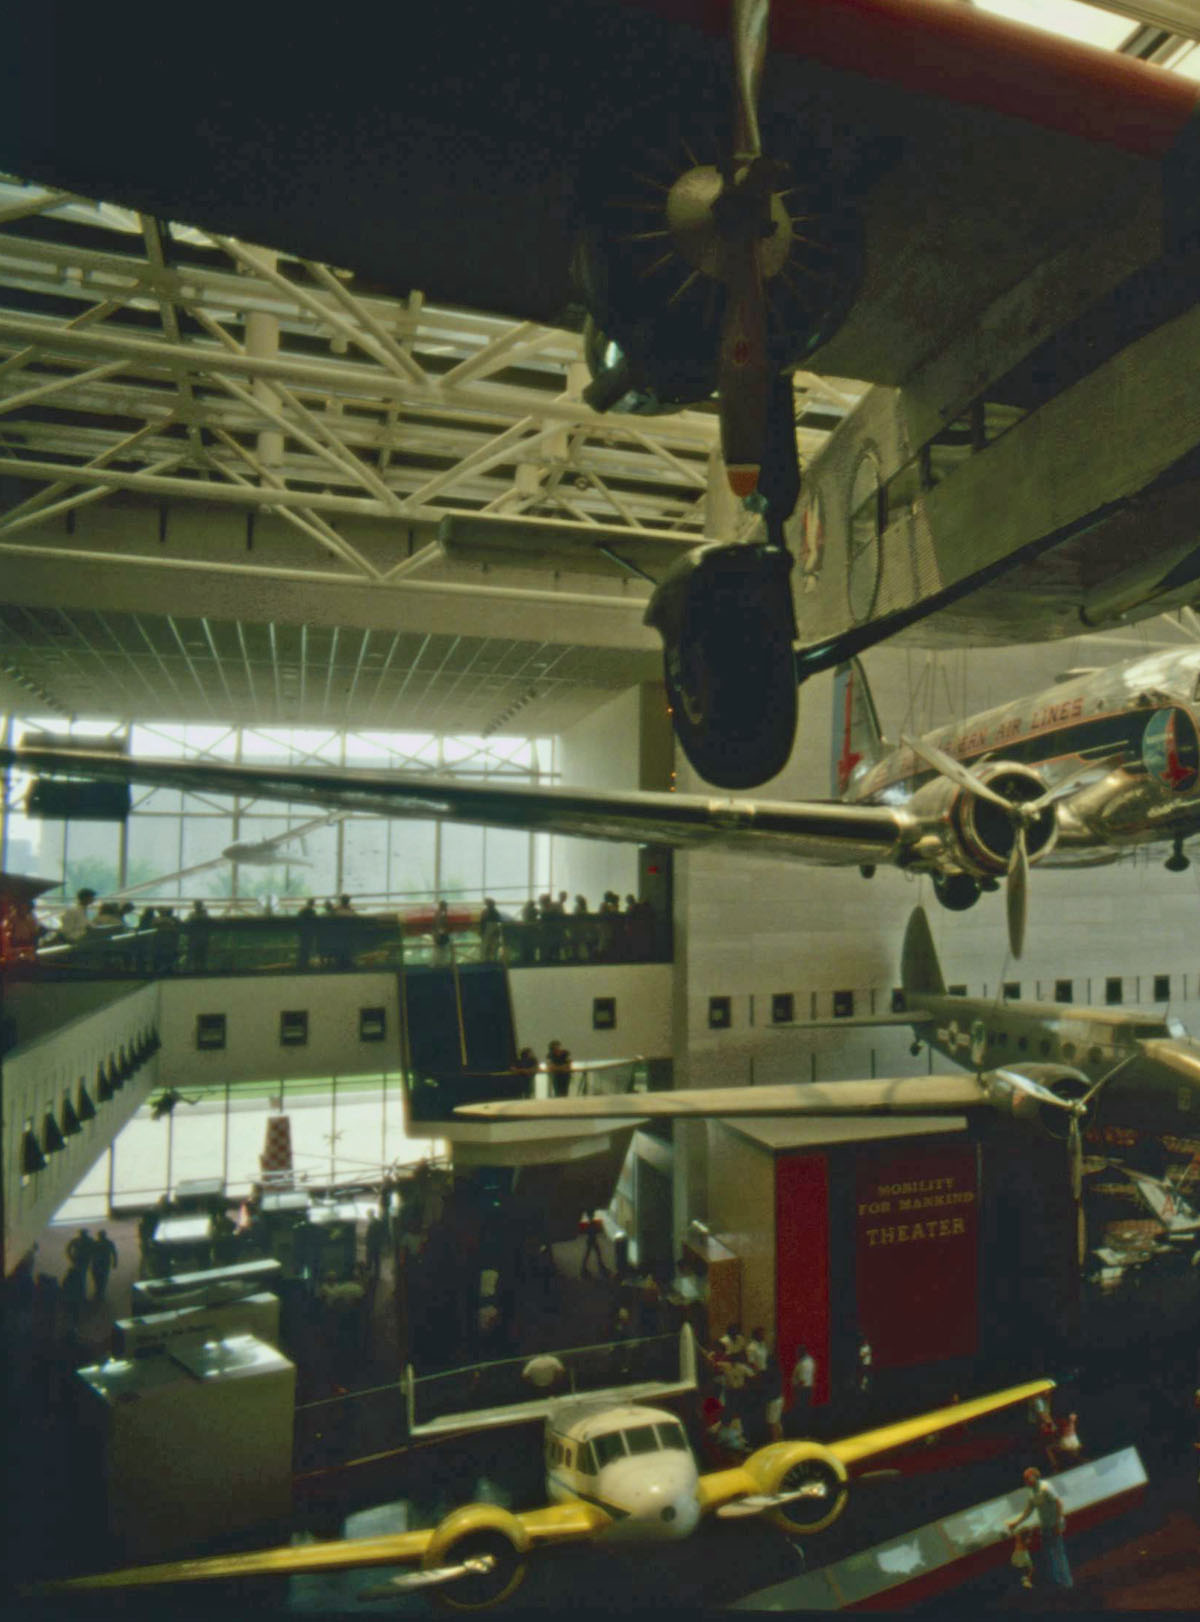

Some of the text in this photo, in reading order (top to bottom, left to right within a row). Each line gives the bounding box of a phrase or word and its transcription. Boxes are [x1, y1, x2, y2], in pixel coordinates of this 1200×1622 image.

[1030, 698, 1084, 730] LINES
[878, 1177, 954, 1197] MOBILITY
[858, 1190, 975, 1216] FOR MANKIND
[866, 1217, 966, 1247] THEATER
